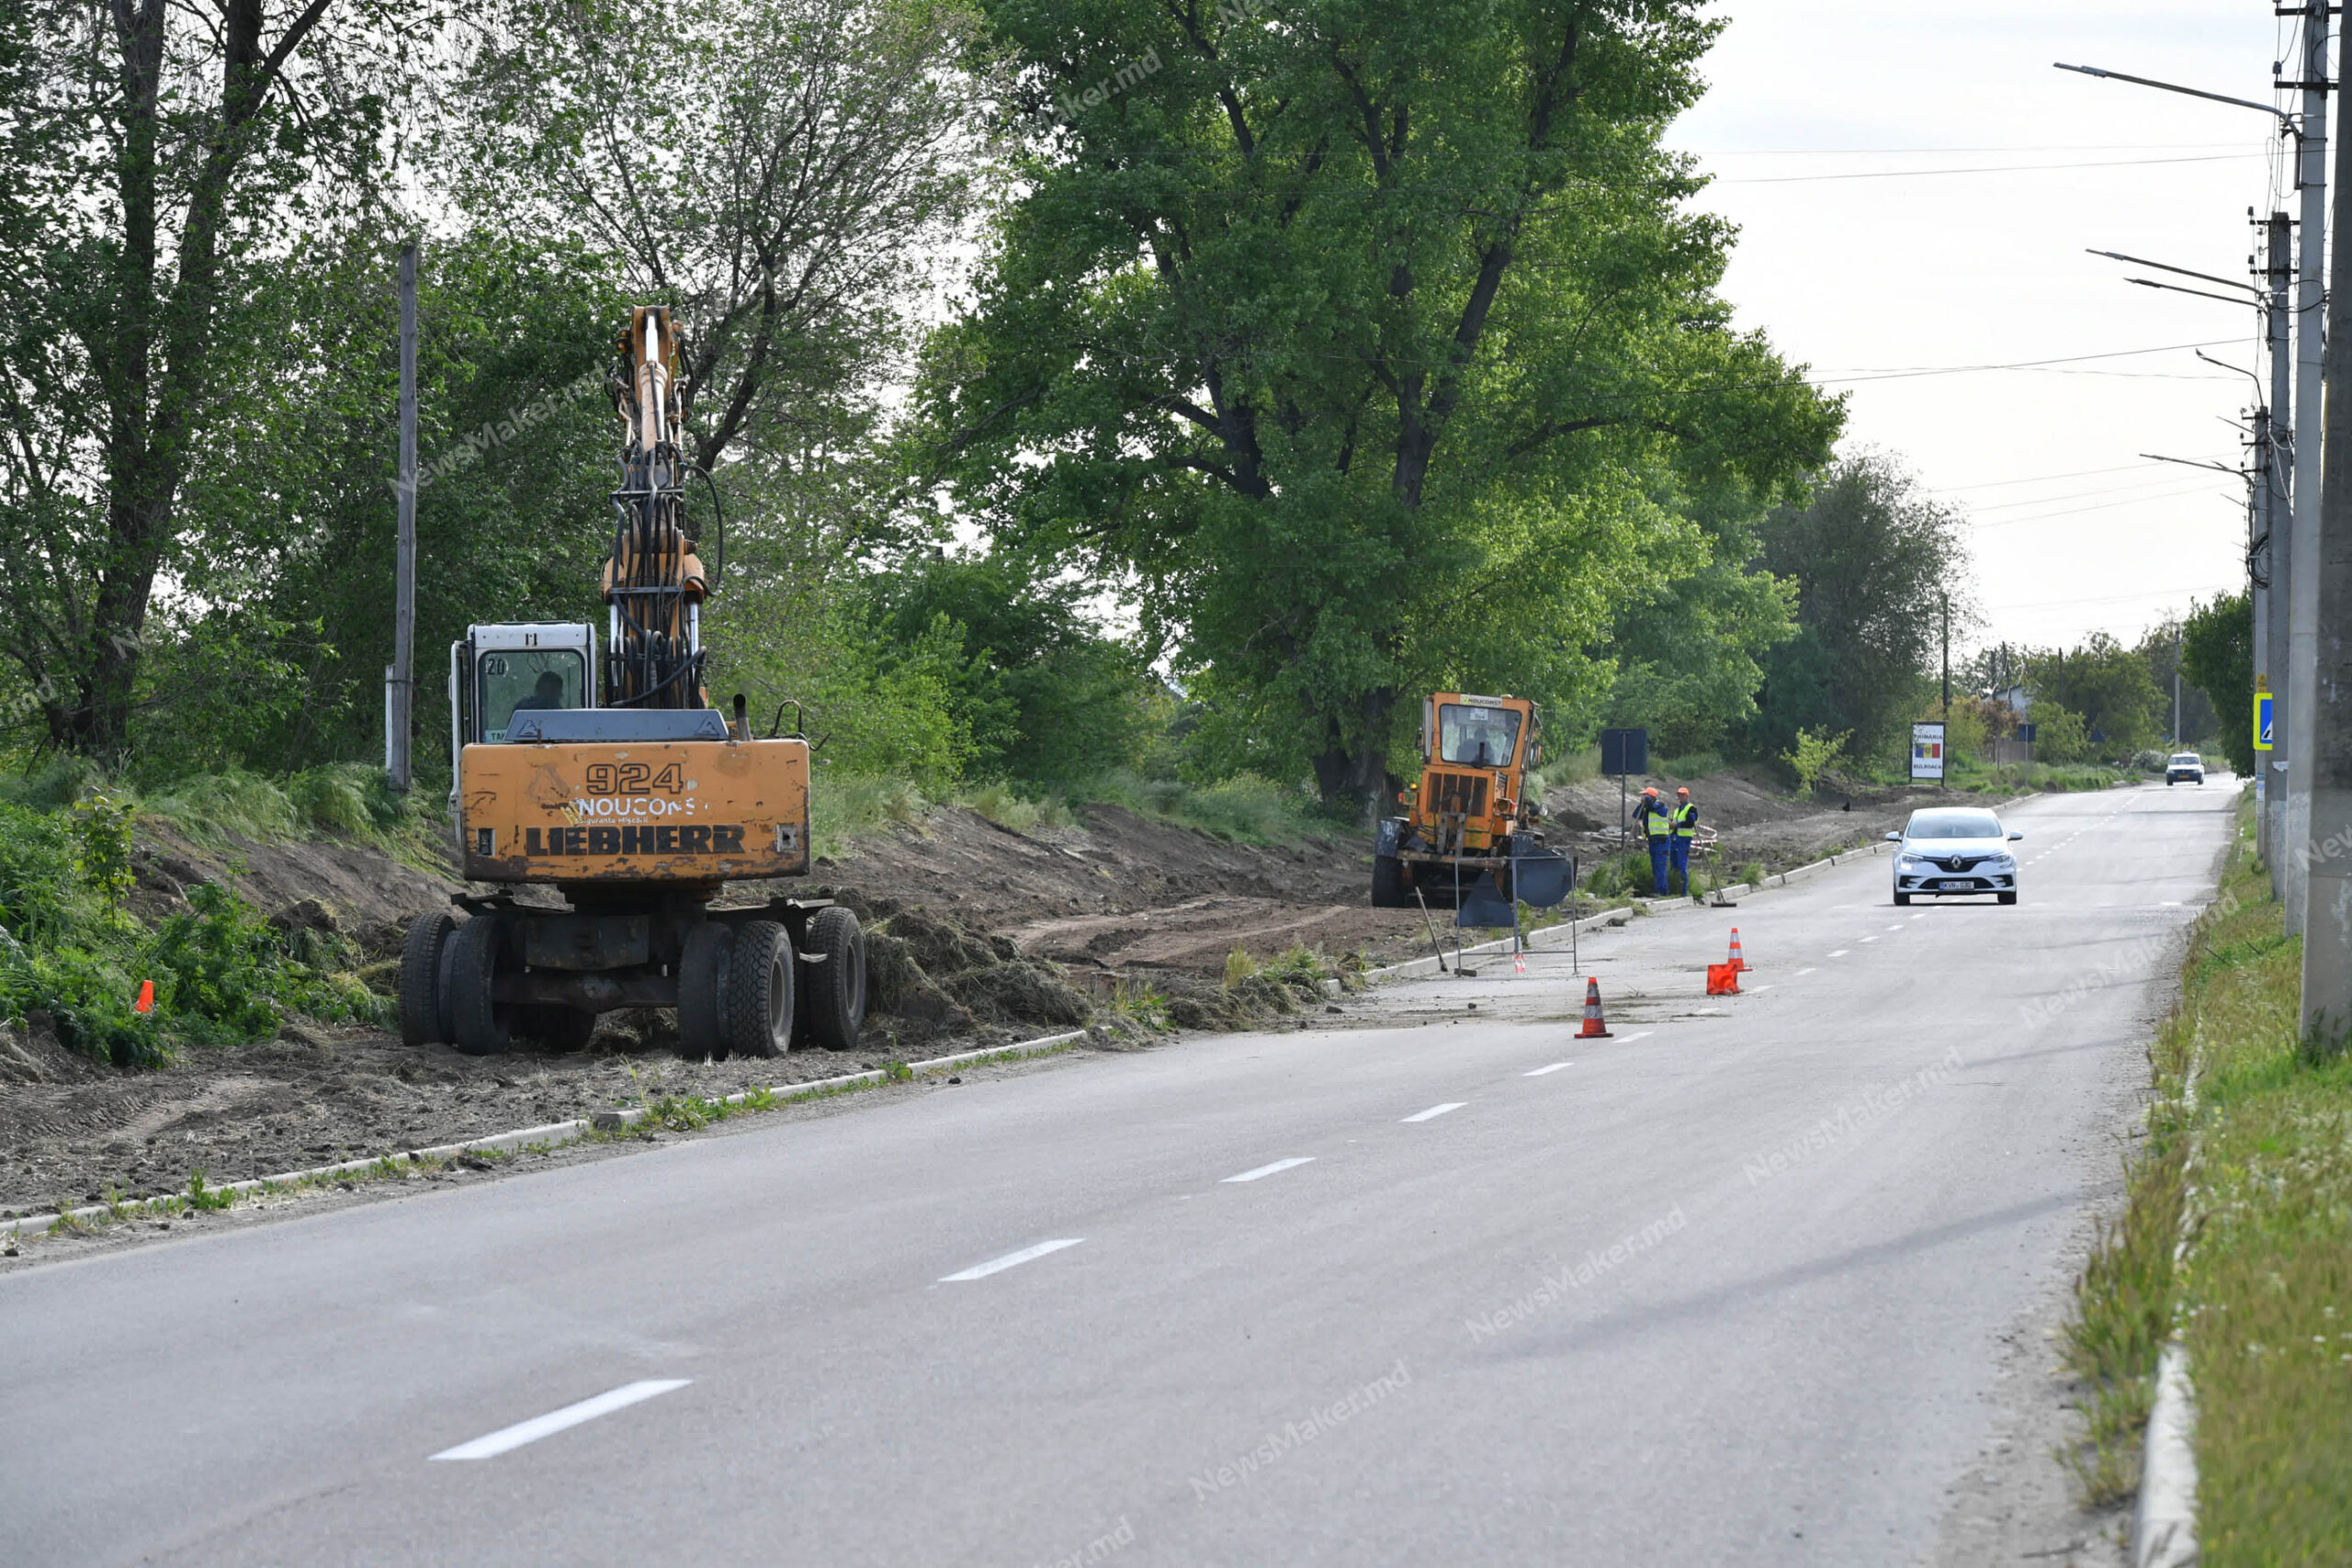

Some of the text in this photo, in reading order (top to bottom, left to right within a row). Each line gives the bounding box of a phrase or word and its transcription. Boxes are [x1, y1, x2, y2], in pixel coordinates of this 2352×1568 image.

[487, 659, 504, 675] 20
[586, 763, 684, 795] 924
[526, 825, 745, 856] LIEBHERR
